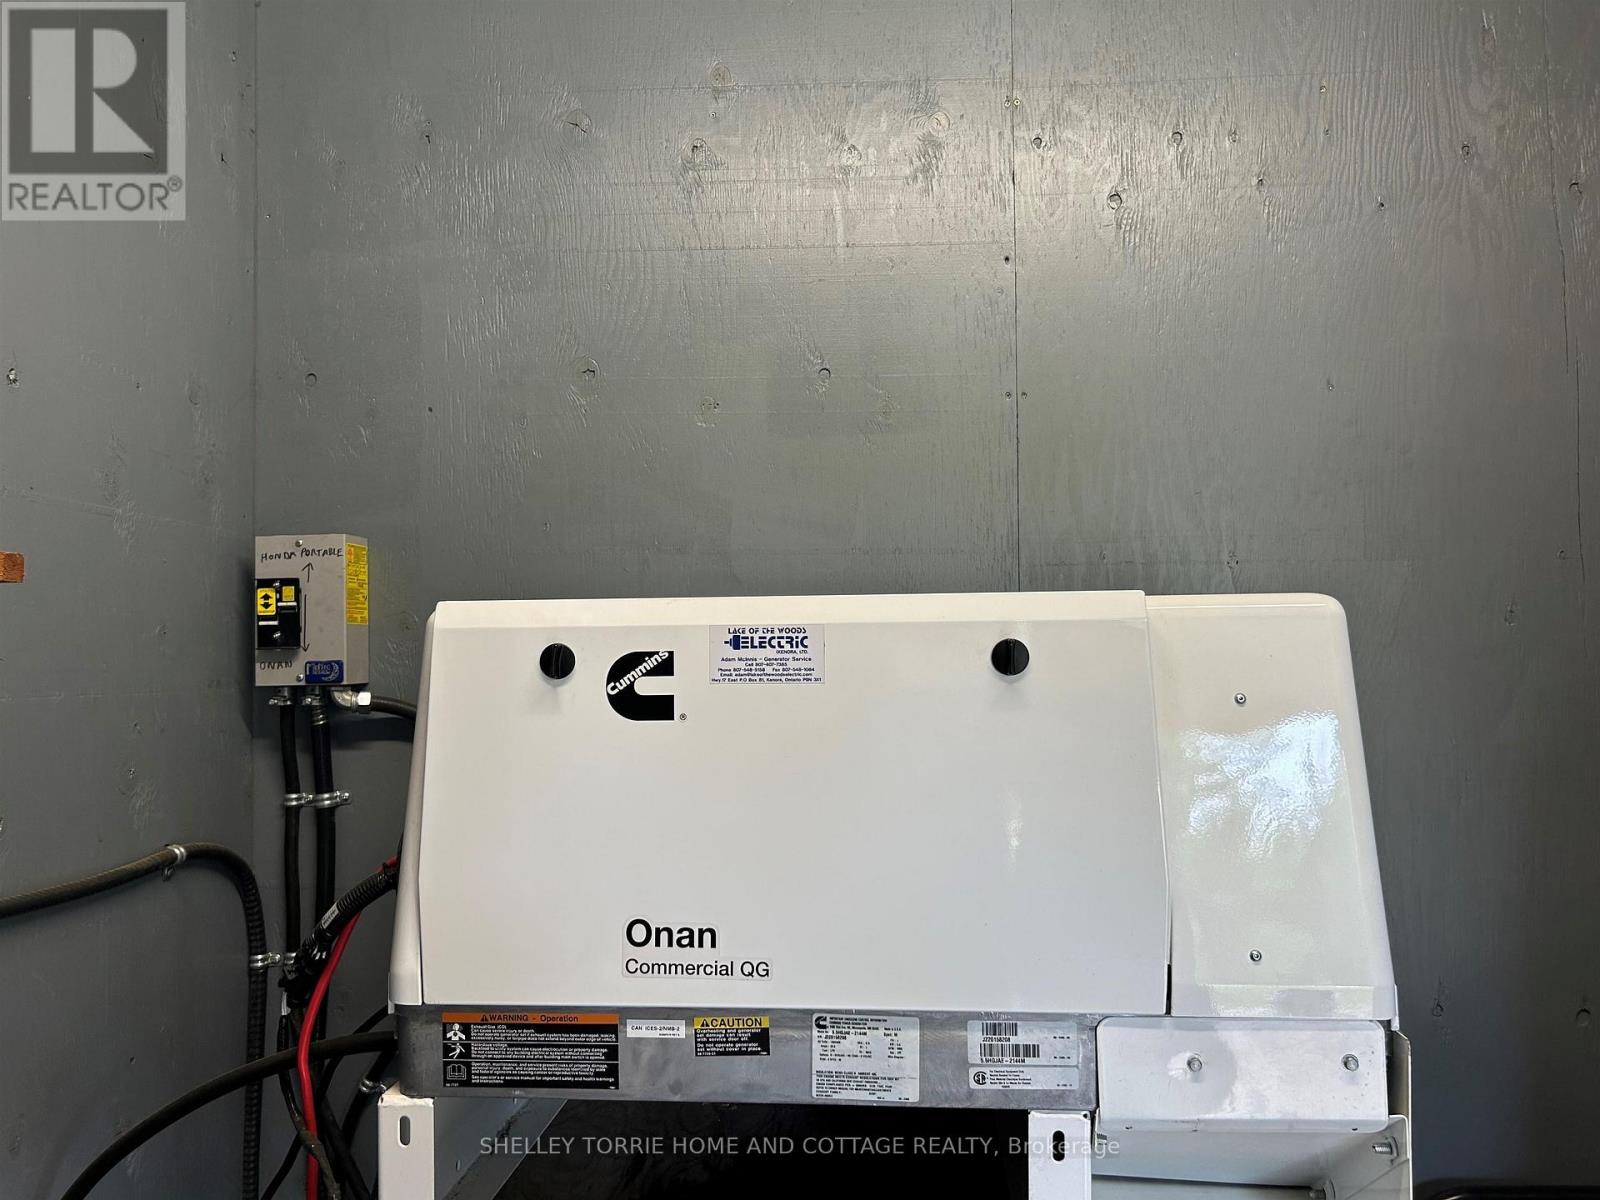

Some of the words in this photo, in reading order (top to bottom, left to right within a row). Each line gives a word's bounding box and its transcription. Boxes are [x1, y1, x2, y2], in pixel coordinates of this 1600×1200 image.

[261, 552, 296, 562] HONDA
[300, 548, 344, 558] PORTABLE
[741, 636, 808, 648] ELECTRIC
[260, 662, 293, 670] ONAN
[607, 651, 669, 695] Cummins
[626, 918, 716, 948] Onan
[625, 958, 734, 976] Commercial
[740, 961, 770, 978] QG
[711, 1018, 762, 1027] CAUTION
